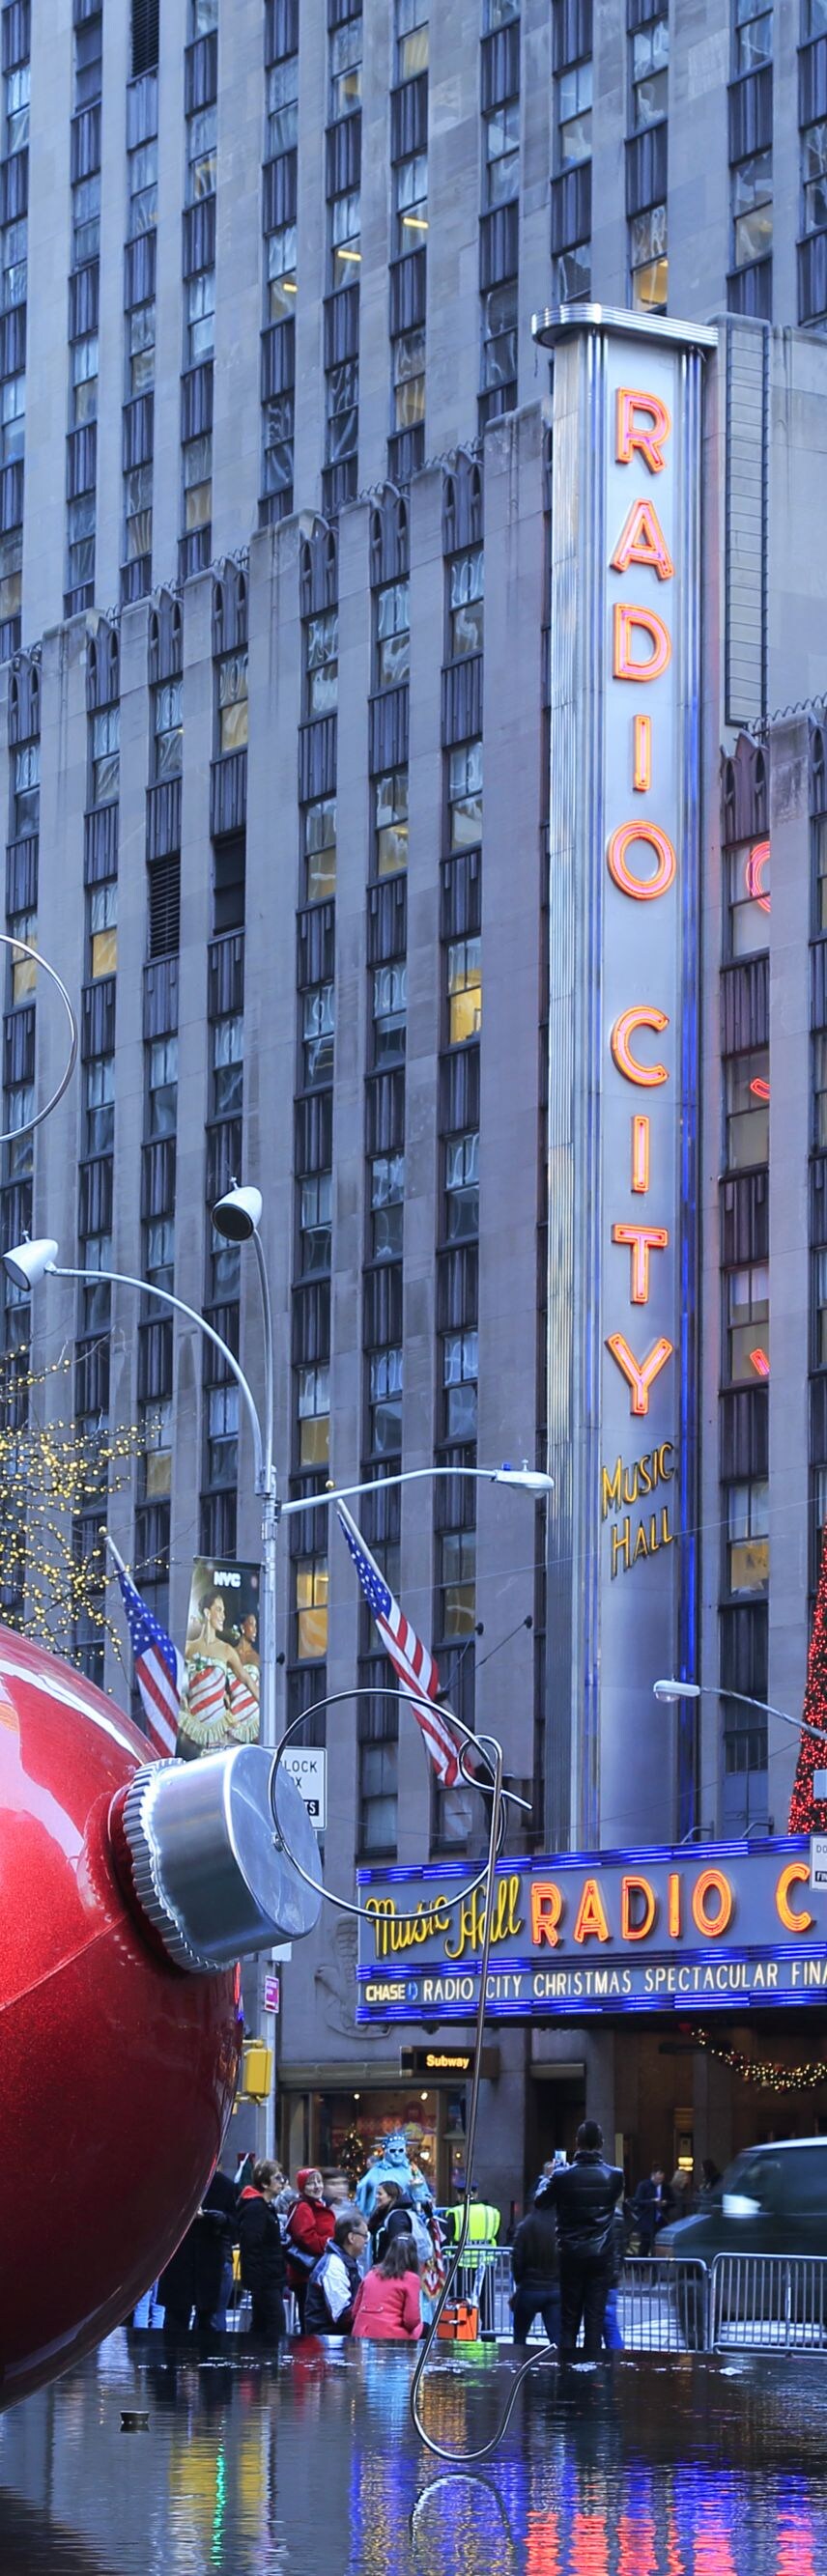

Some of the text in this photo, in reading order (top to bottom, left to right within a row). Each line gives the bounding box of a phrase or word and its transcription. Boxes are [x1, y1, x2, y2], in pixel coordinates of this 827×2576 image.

[606, 386, 676, 1416] RADIO CITY
[602, 1442, 674, 1519] MUSIC
[611, 1507, 673, 1579] HALL
[214, 1571, 242, 1588] NYC
[281, 1760, 318, 1773] LOCK
[365, 1875, 523, 1959] Music Hall
[530, 1867, 734, 1948] RADIO
[365, 1983, 407, 2002] CHASE
[423, 1977, 474, 2001] RADIO
[485, 1975, 523, 1998] CITY
[533, 1969, 632, 1997] CHRISTMAS
[644, 1963, 779, 1993] SPECTACULAR
[426, 2053, 471, 2070] Subway
